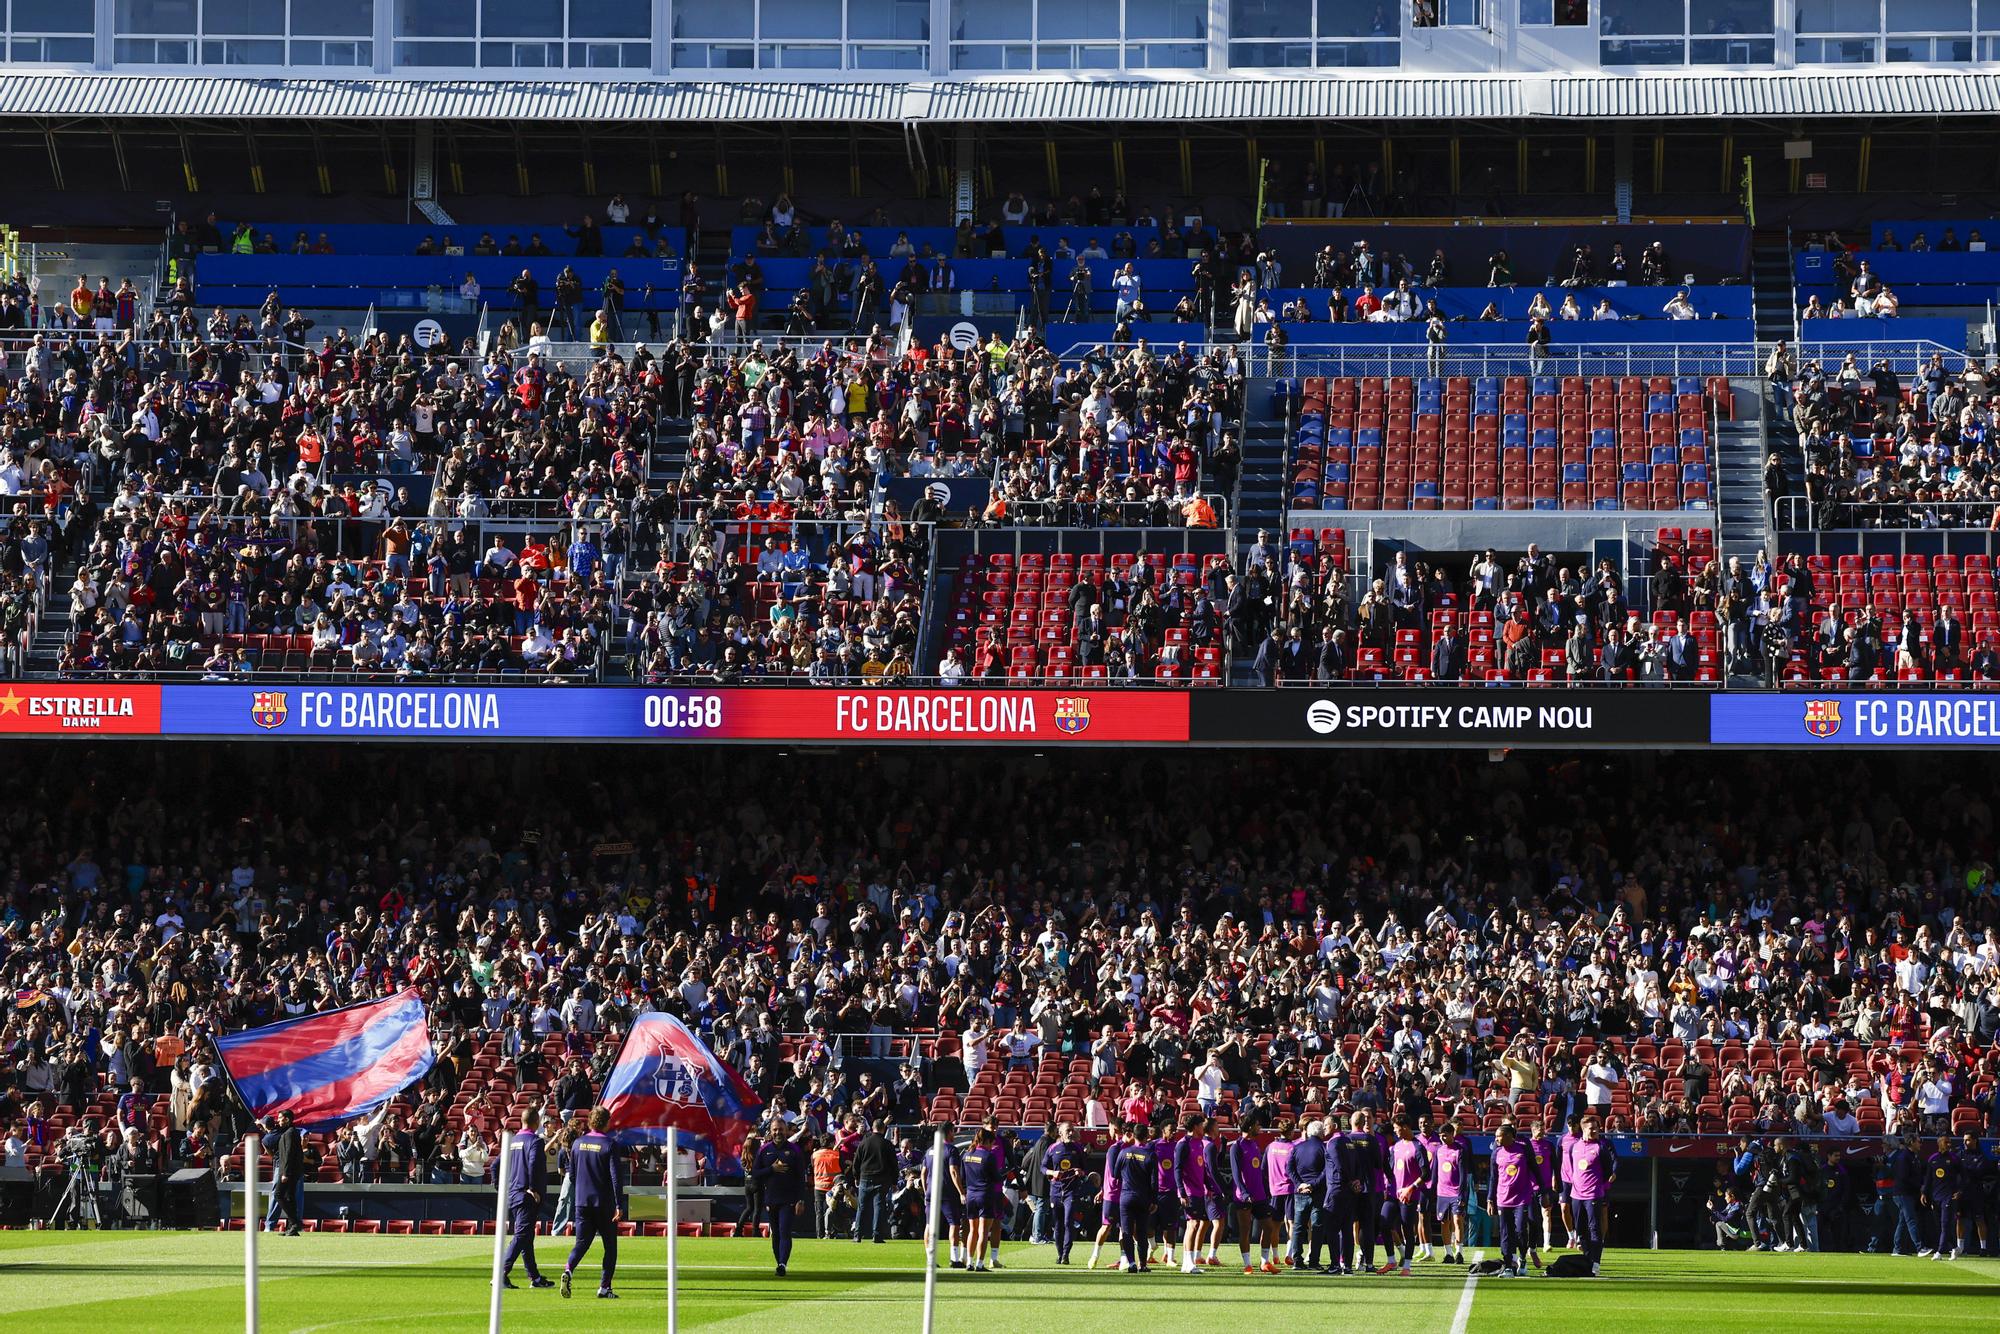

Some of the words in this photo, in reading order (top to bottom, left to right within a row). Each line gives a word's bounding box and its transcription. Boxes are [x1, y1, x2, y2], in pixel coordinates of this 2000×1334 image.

[29, 697, 134, 716] ESTRELLA
[63, 717, 100, 727] DAMM
[300, 692, 333, 728] FC
[341, 692, 500, 729] BARCELONA
[644, 695, 722, 728] 00:58
[836, 695, 868, 731] FC
[877, 696, 1037, 732] BARCELONA
[1346, 705, 1453, 728] SPOTIFY
[1458, 706, 1533, 728] CAMP
[1539, 706, 1592, 729] NOU
[1855, 700, 1888, 736] FC
[1896, 700, 2000, 737] BARCEL
